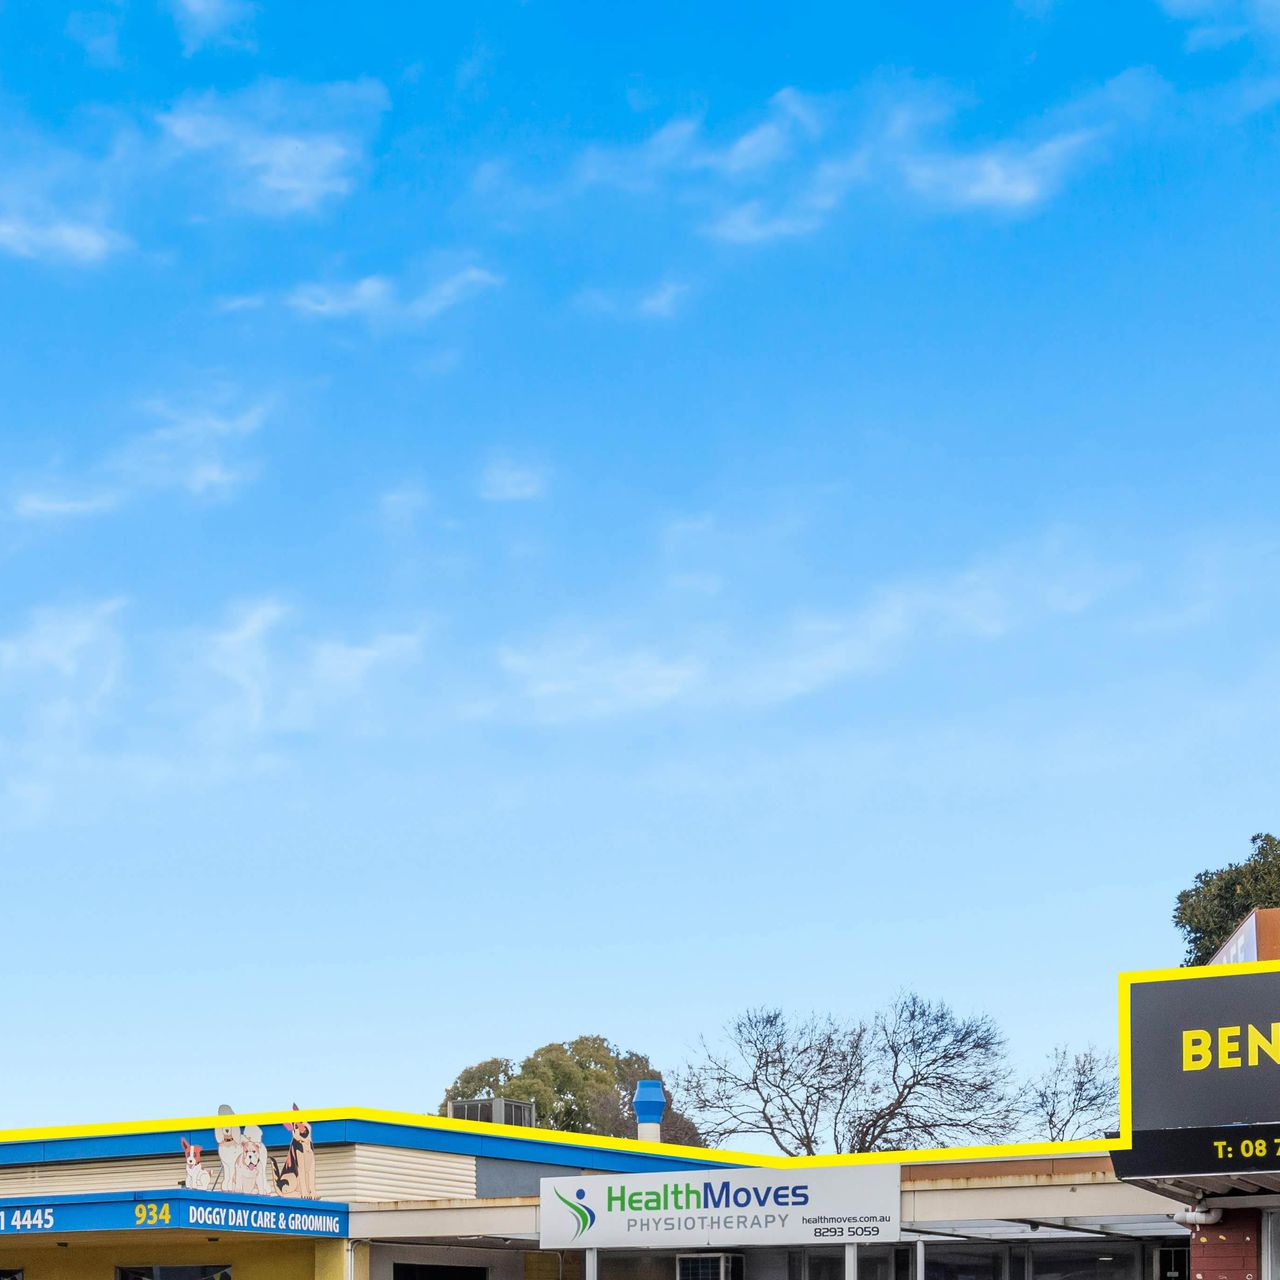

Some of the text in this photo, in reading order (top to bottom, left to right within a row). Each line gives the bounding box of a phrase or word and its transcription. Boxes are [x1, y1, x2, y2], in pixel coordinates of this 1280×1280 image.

[1214, 1141, 1233, 1159] T:
[1239, 1139, 1267, 1158] 08
[607, 1181, 809, 1212] HealthMoves
[10, 1208, 54, 1230] 4445
[135, 1202, 171, 1225] 934
[189, 1205, 340, 1233] DOGGY DAY CARE & GROOMING
[627, 1213, 790, 1233] PHYSIOTHERAPY
[802, 1214, 891, 1225] healthmoves.com.au
[813, 1226, 880, 1238] 8293 5059
